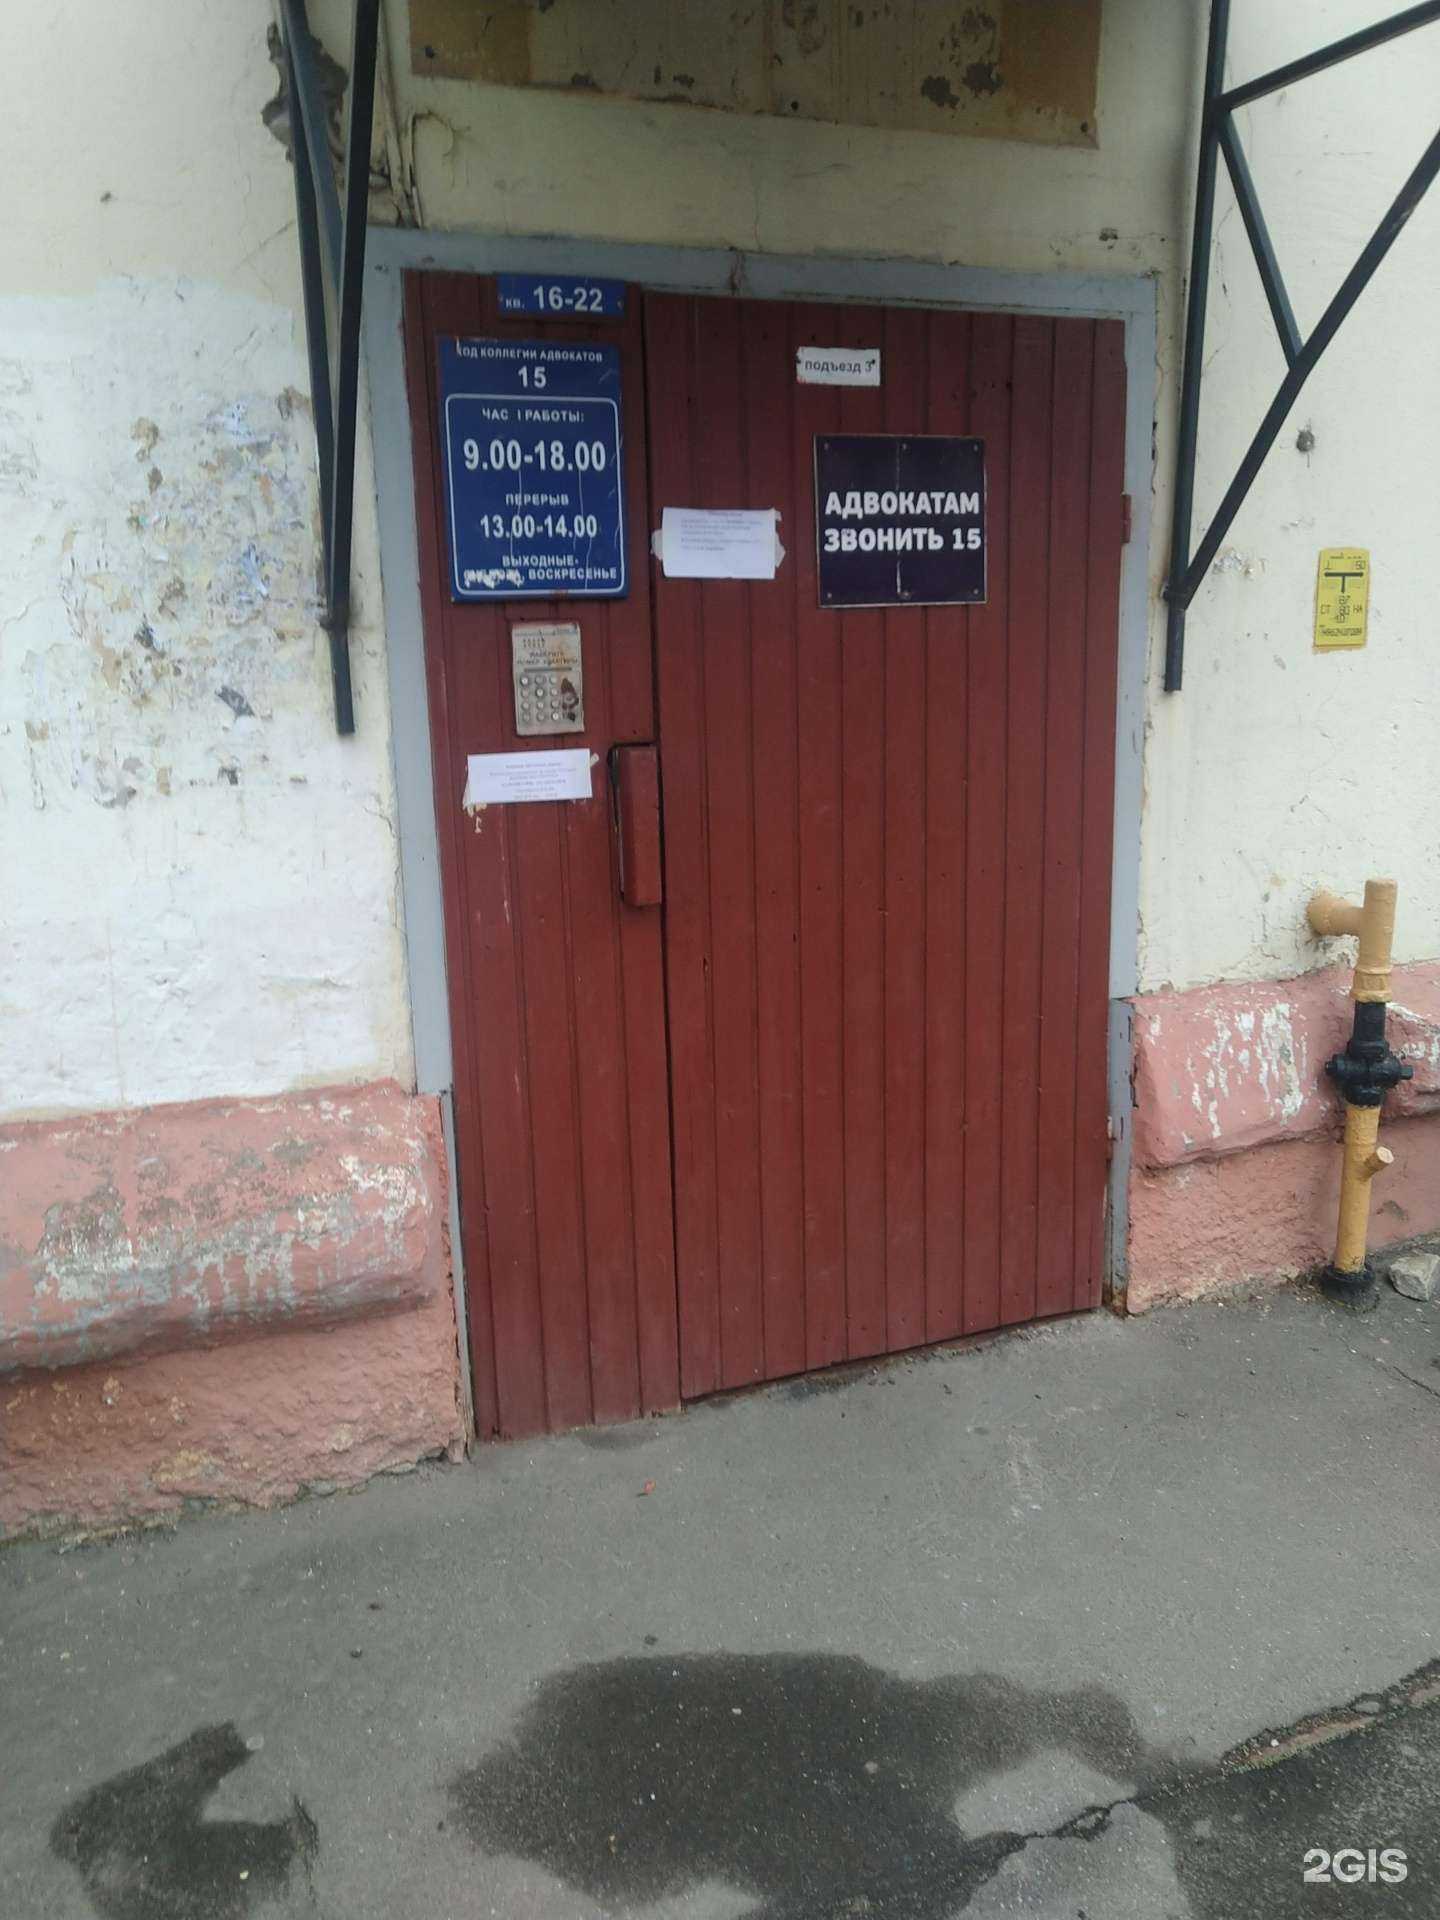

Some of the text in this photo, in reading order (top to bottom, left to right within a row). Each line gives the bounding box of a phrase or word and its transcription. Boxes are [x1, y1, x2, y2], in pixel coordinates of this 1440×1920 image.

[534, 285, 603, 312] 16-22
[540, 350, 602, 362] АДВОКАТОВ
[804, 360, 861, 374] подъезд
[518, 366, 547, 388] 15
[463, 438, 606, 471] 9.00-18.00
[505, 493, 569, 506] ПЕРЕРЫВ
[825, 491, 980, 519] АДВОКАТАМ
[480, 514, 597, 538] 13.00-14.00
[824, 528, 982, 551] ЗВОНИТЬ 15
[528, 567, 617, 581] ВОСКРЕСЕНЬЕ
